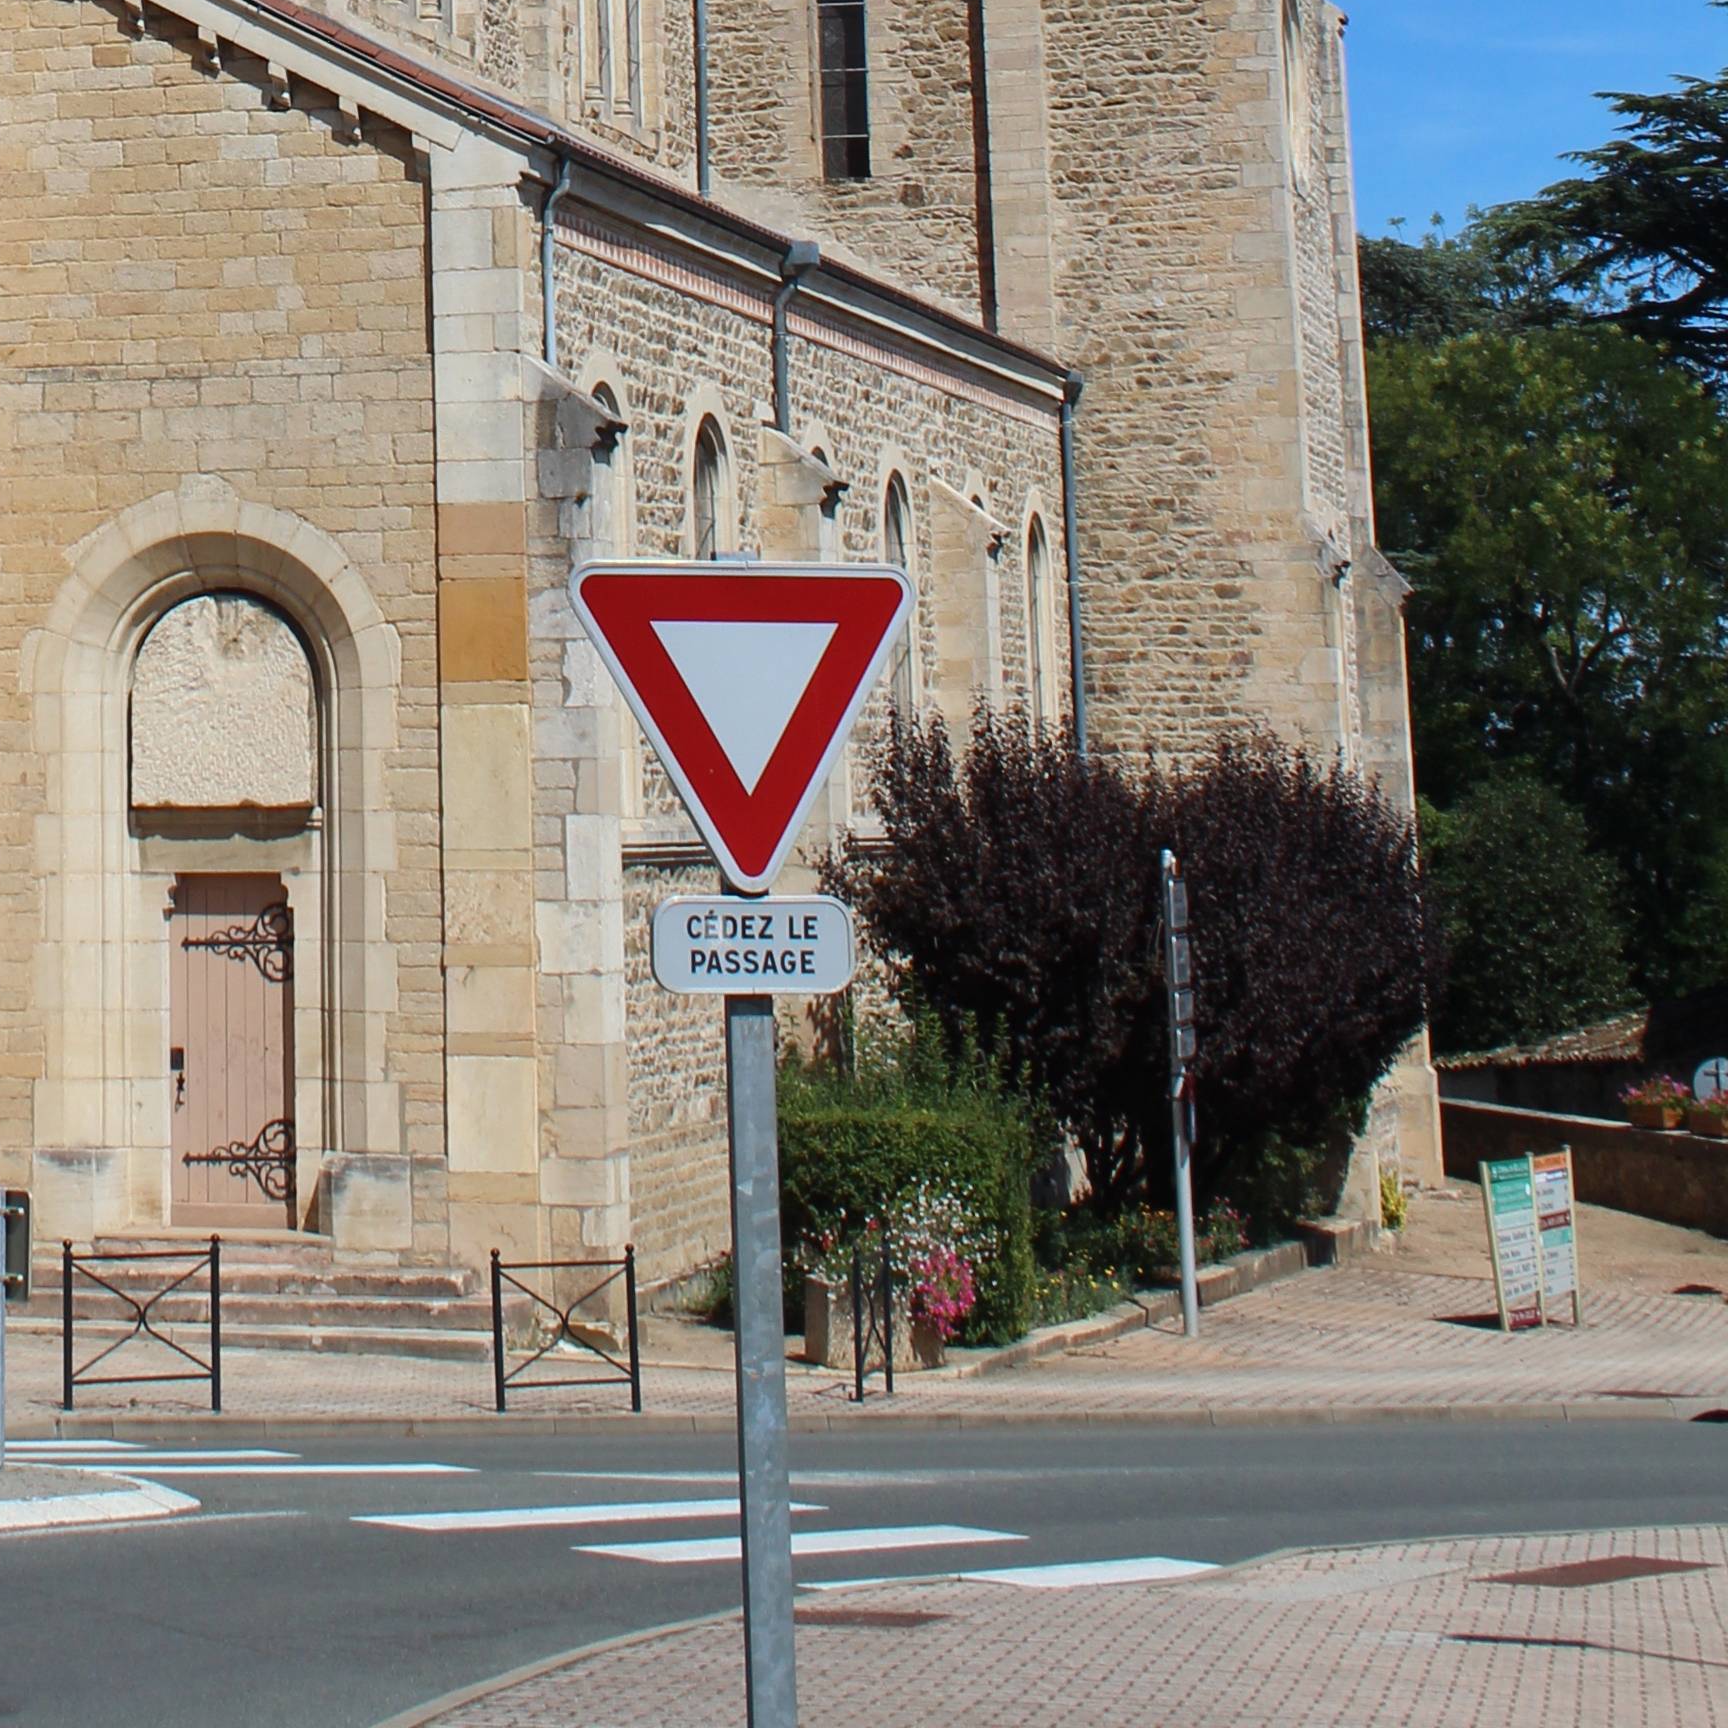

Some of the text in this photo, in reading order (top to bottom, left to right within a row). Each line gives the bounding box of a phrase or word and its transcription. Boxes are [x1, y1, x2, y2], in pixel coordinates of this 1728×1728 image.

[686, 910, 818, 939] CÉDEZ LE
[690, 950, 815, 974] PASSAGE
